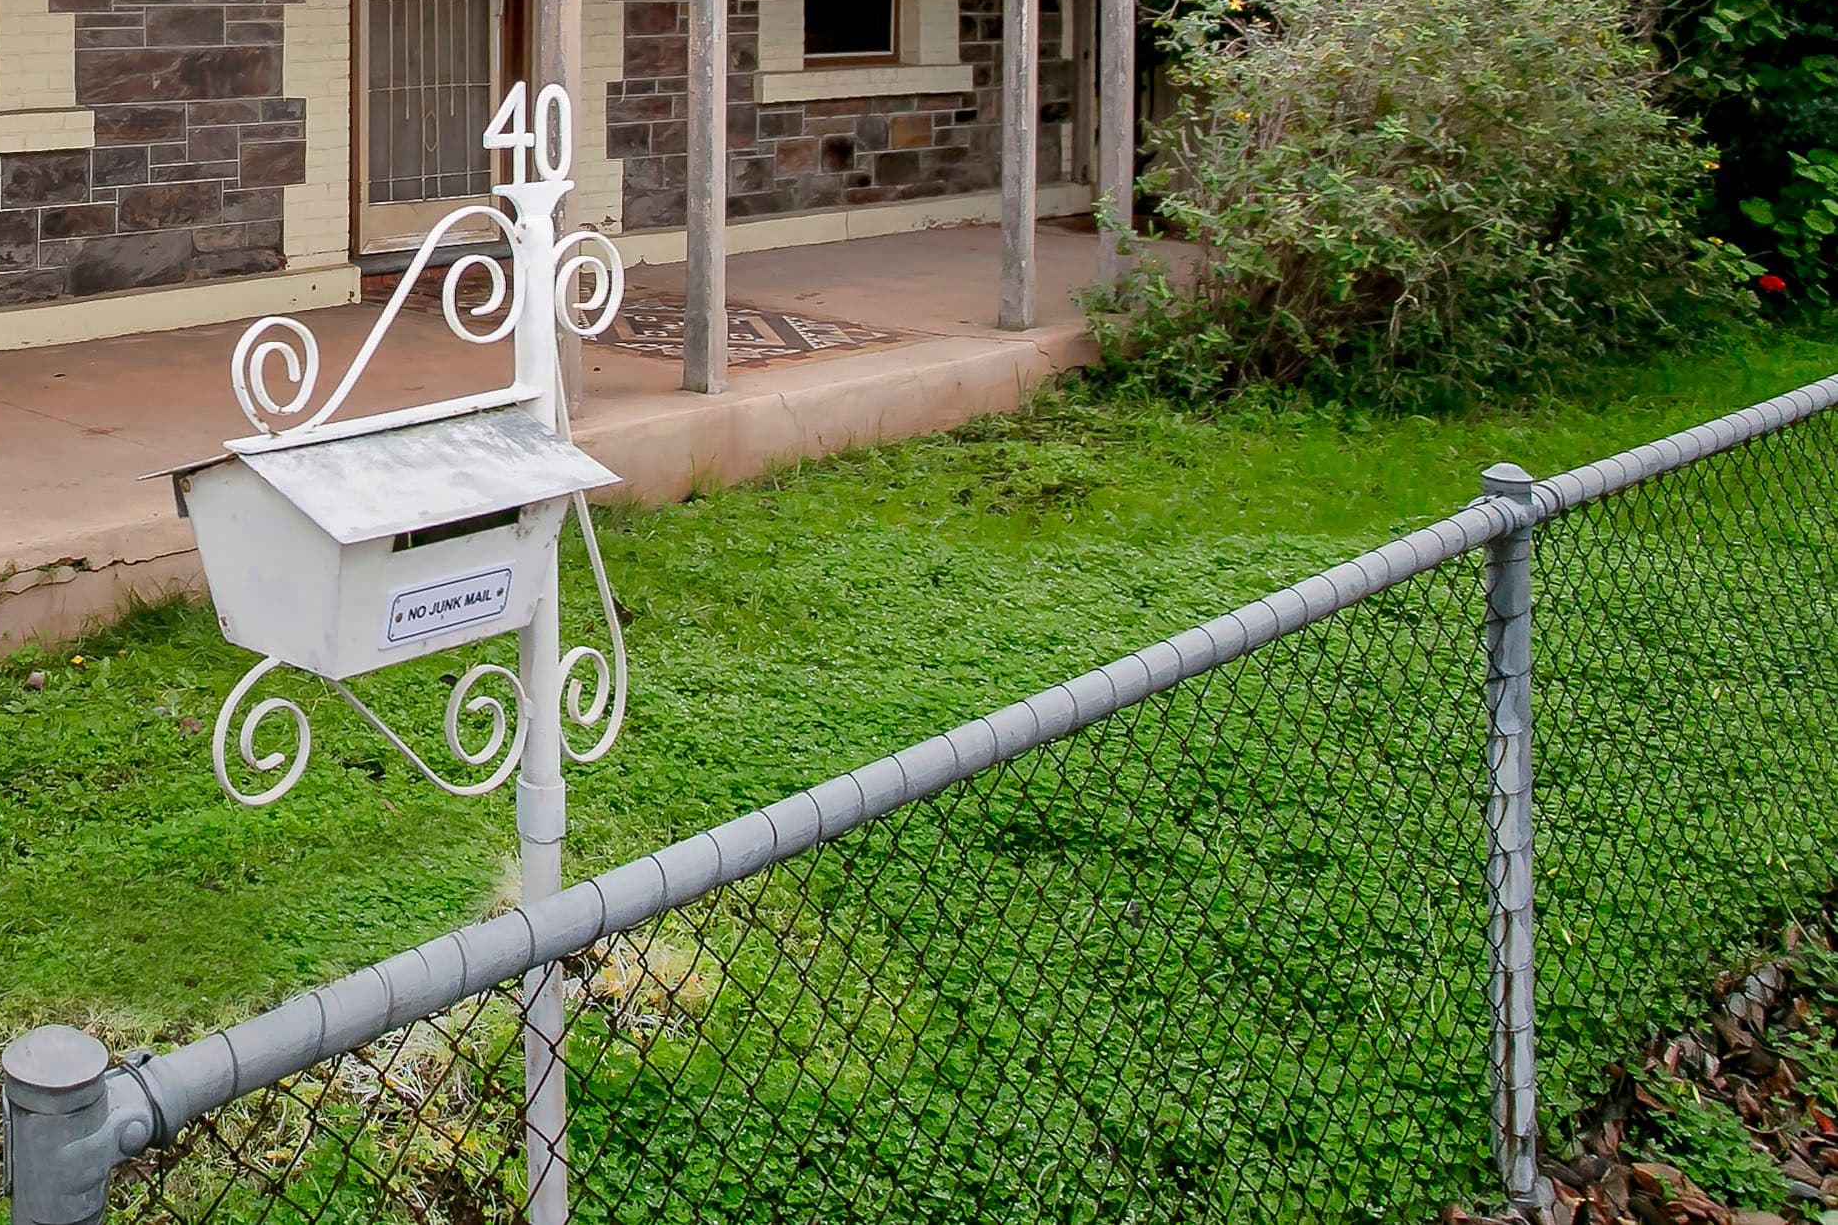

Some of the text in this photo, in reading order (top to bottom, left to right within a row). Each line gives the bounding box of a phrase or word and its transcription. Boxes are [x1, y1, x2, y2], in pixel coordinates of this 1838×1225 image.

[483, 80, 572, 184] 40
[408, 589, 492, 621] NO JUNK MAIL
